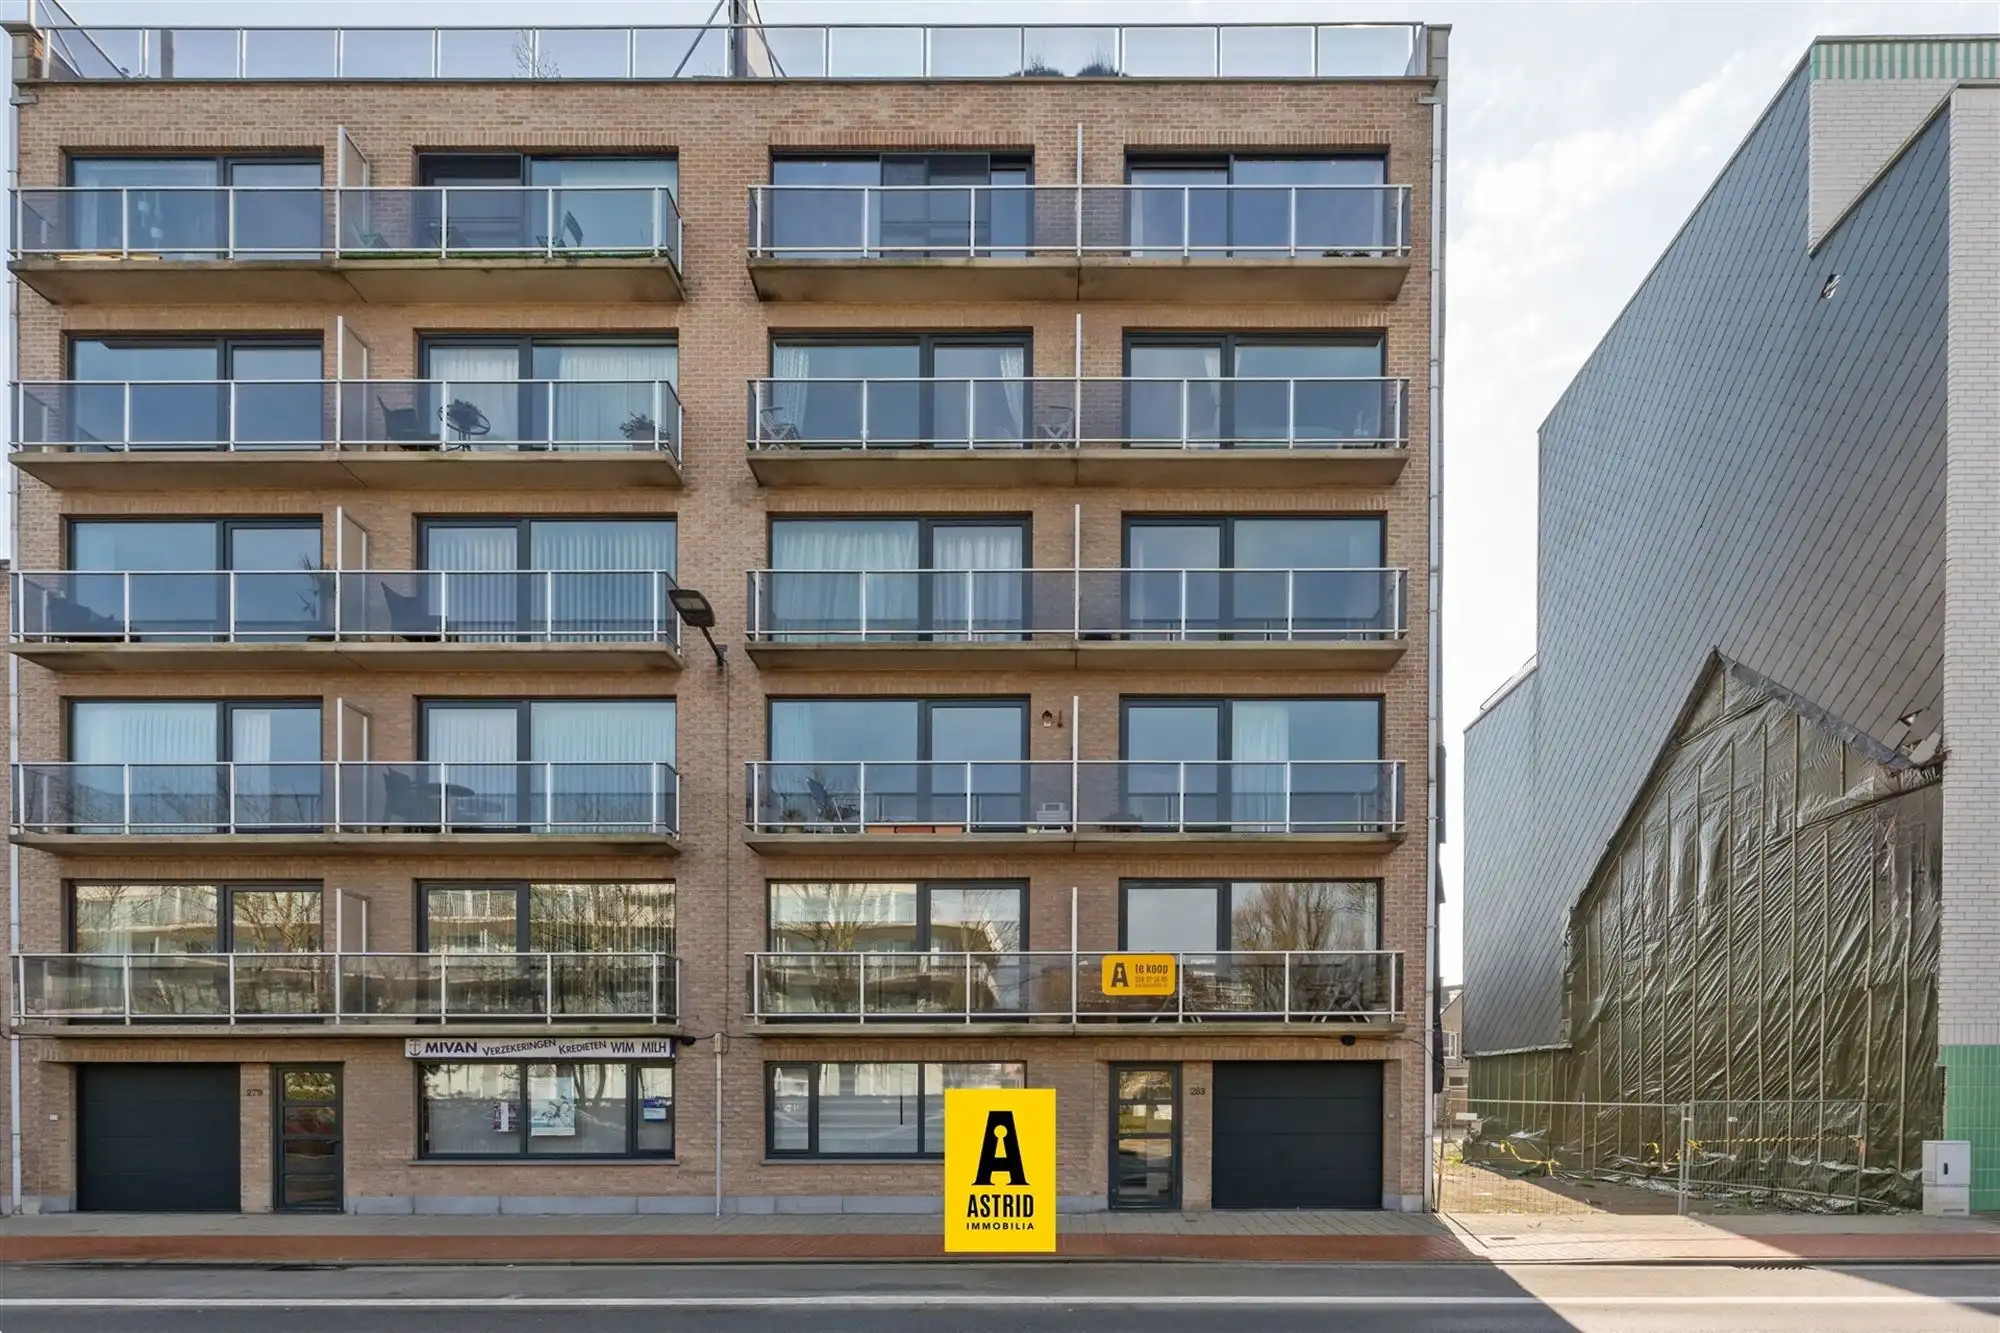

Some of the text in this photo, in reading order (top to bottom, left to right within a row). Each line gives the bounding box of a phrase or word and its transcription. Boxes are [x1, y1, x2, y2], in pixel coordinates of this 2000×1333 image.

[1111, 963, 1129, 987] A
[1135, 963, 1168, 974] te koop
[425, 1038, 667, 1056] MIVAN VERZEKERINGEN KREDIETEN WIM MILH
[1190, 1086, 1205, 1096] 283
